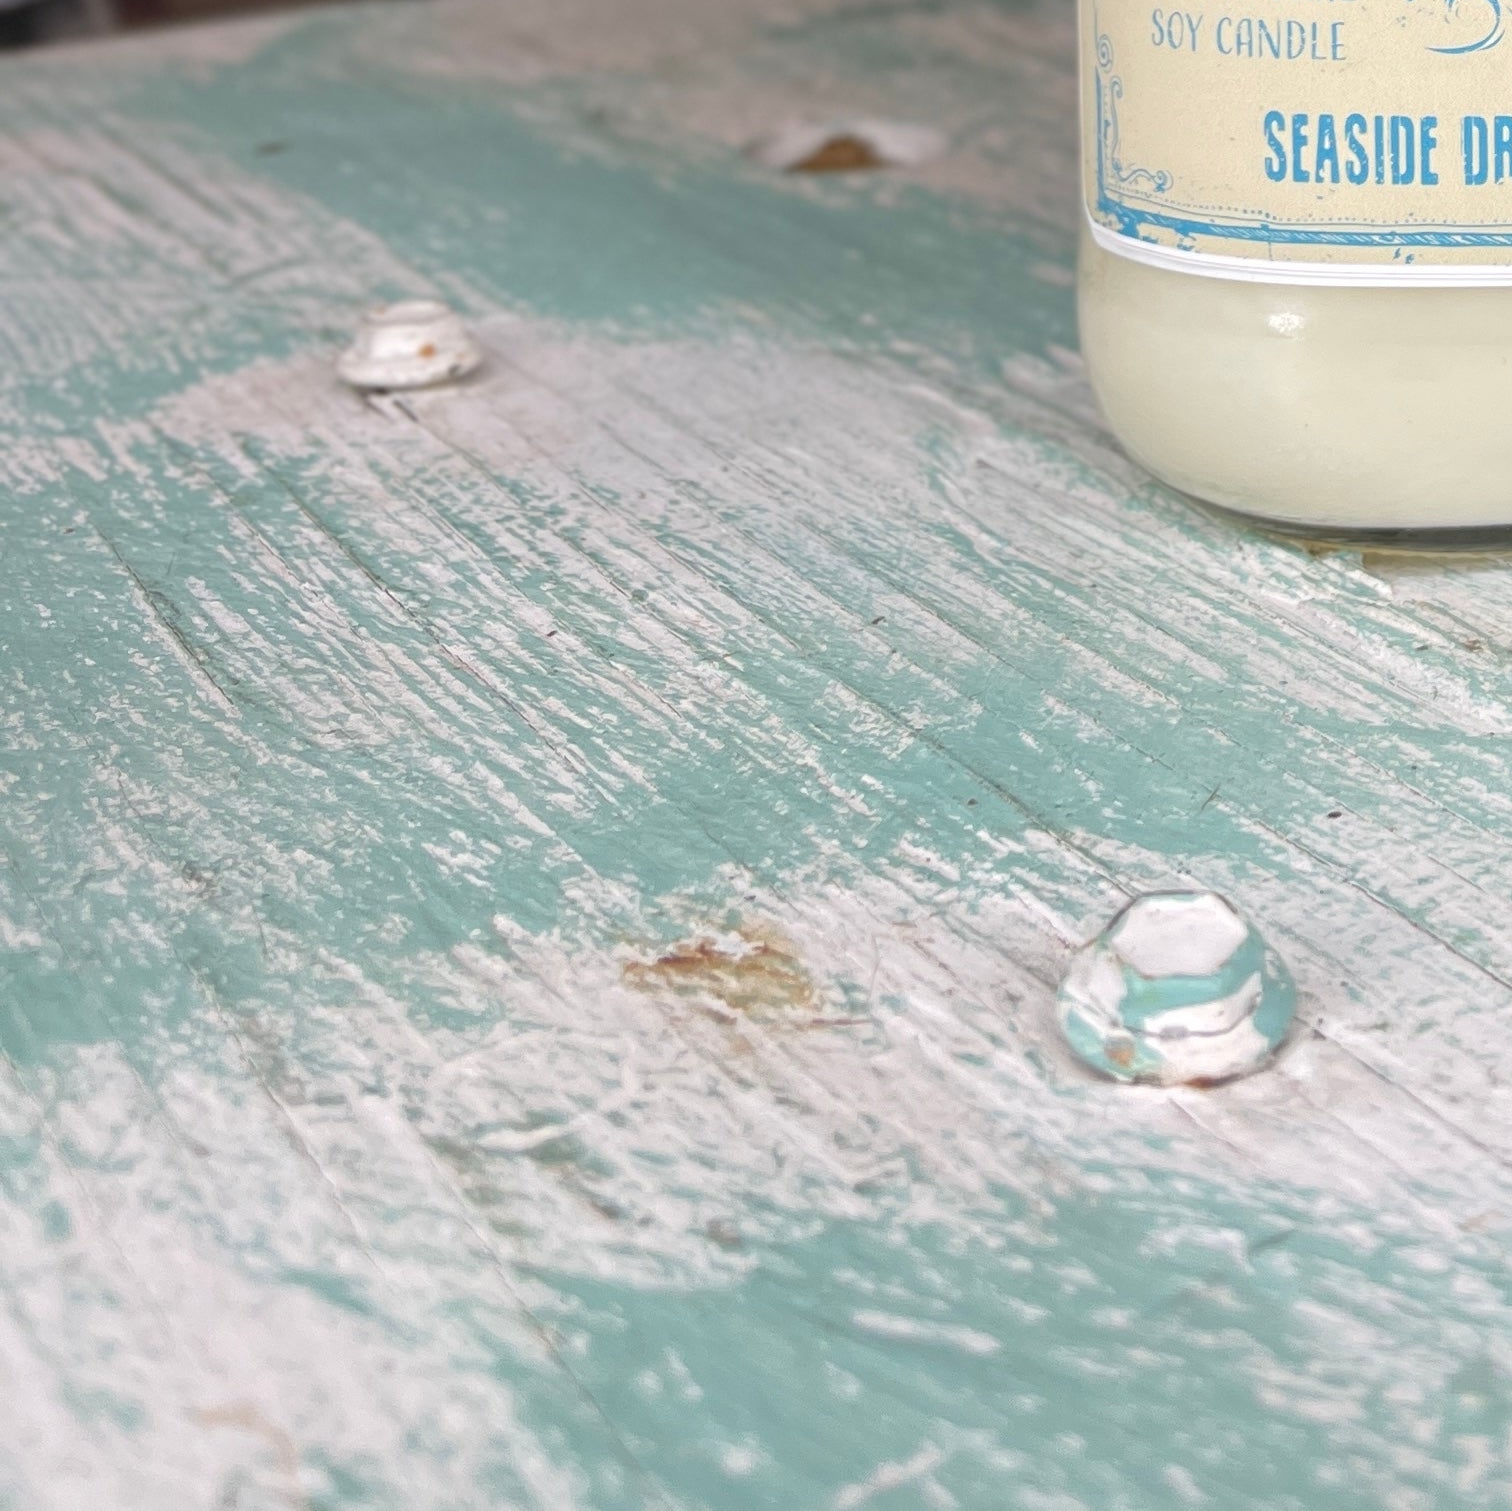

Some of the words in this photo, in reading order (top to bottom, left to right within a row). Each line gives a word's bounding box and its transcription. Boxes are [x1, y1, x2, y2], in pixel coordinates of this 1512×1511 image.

[1151, 8, 1204, 52] SOY
[1215, 16, 1348, 62] CANDLE
[1262, 110, 1440, 186] SEASIDE
